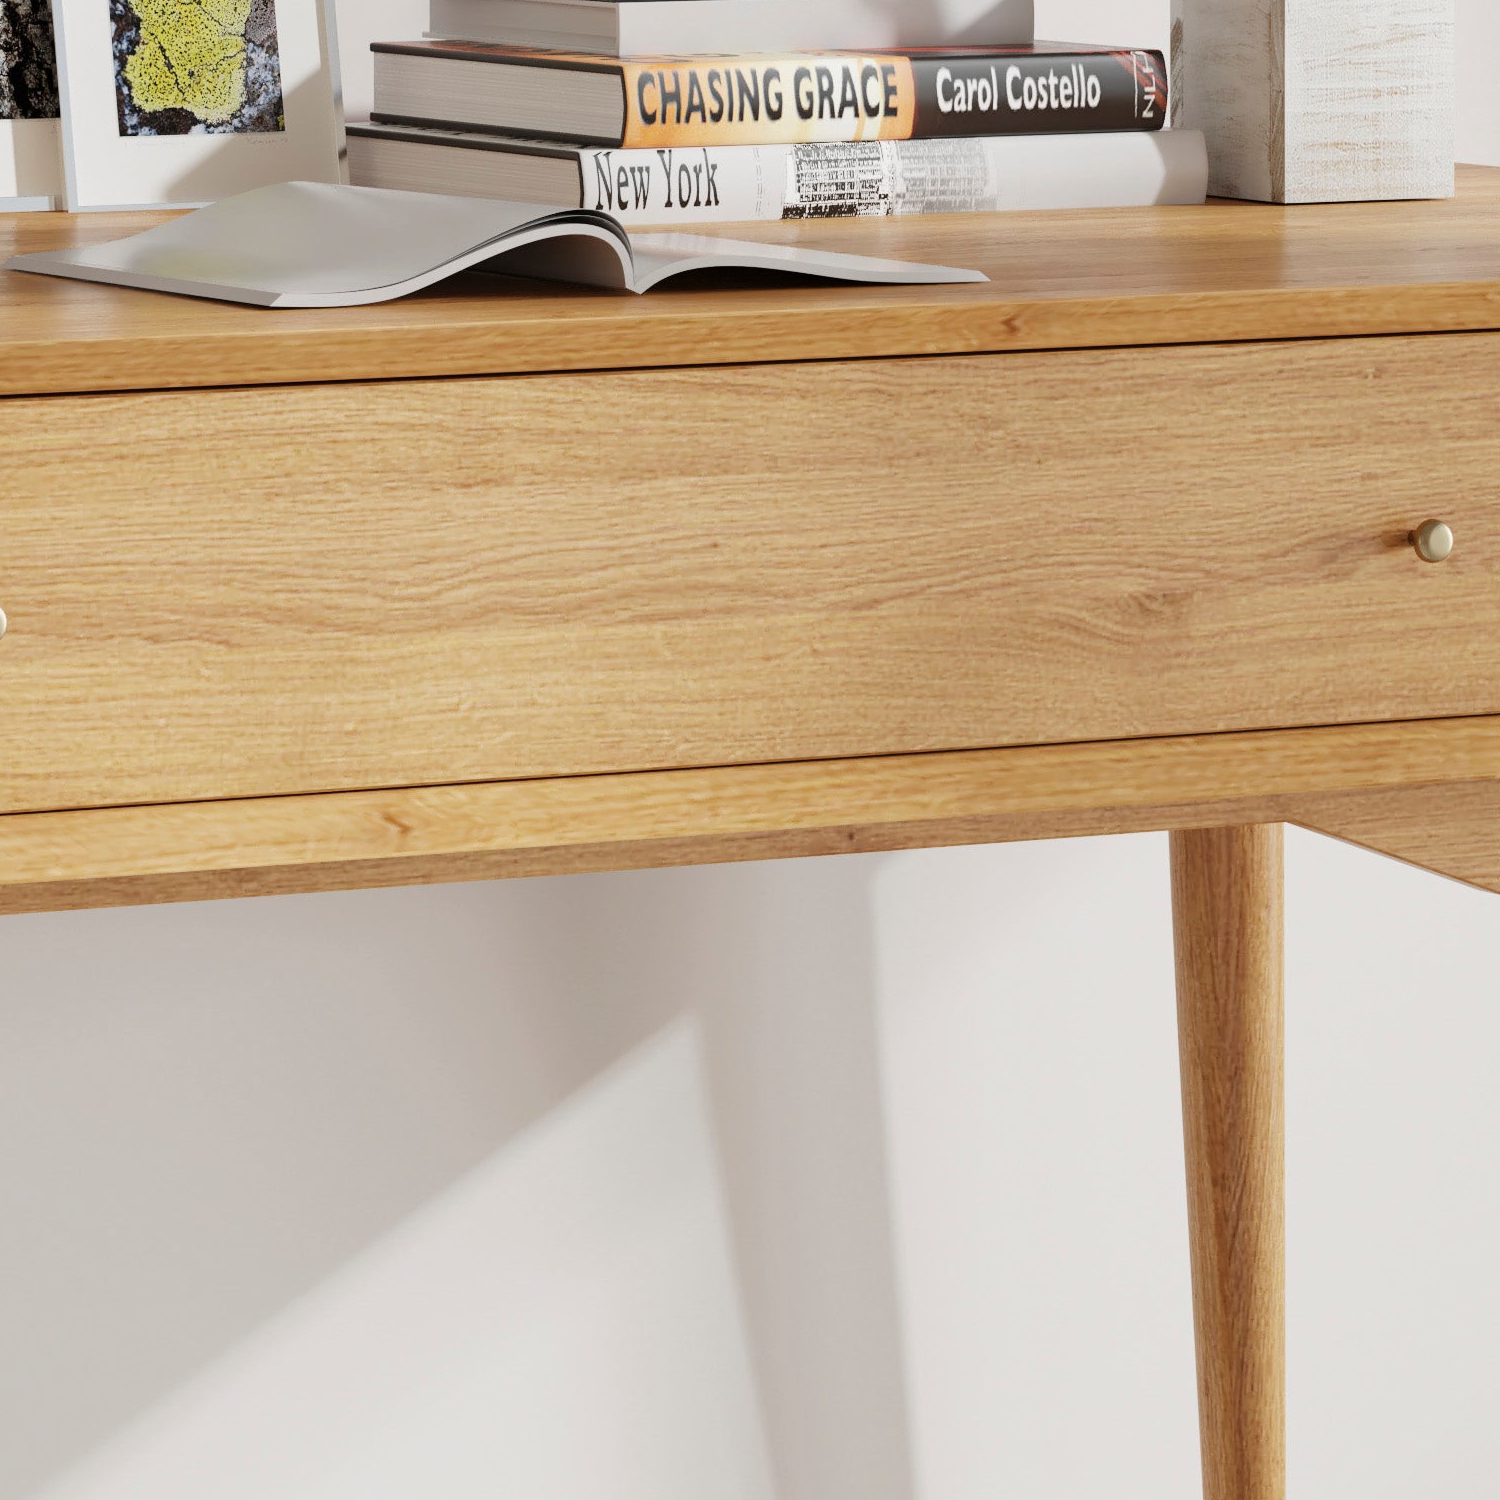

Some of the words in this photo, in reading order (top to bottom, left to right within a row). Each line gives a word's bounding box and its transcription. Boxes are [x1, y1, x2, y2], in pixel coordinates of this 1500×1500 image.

[637, 66, 784, 126] CHASING
[793, 64, 899, 120] GRACE
[936, 65, 999, 114] Carol
[1006, 63, 1102, 111] Costello
[594, 150, 651, 211] New
[657, 147, 720, 209] York
